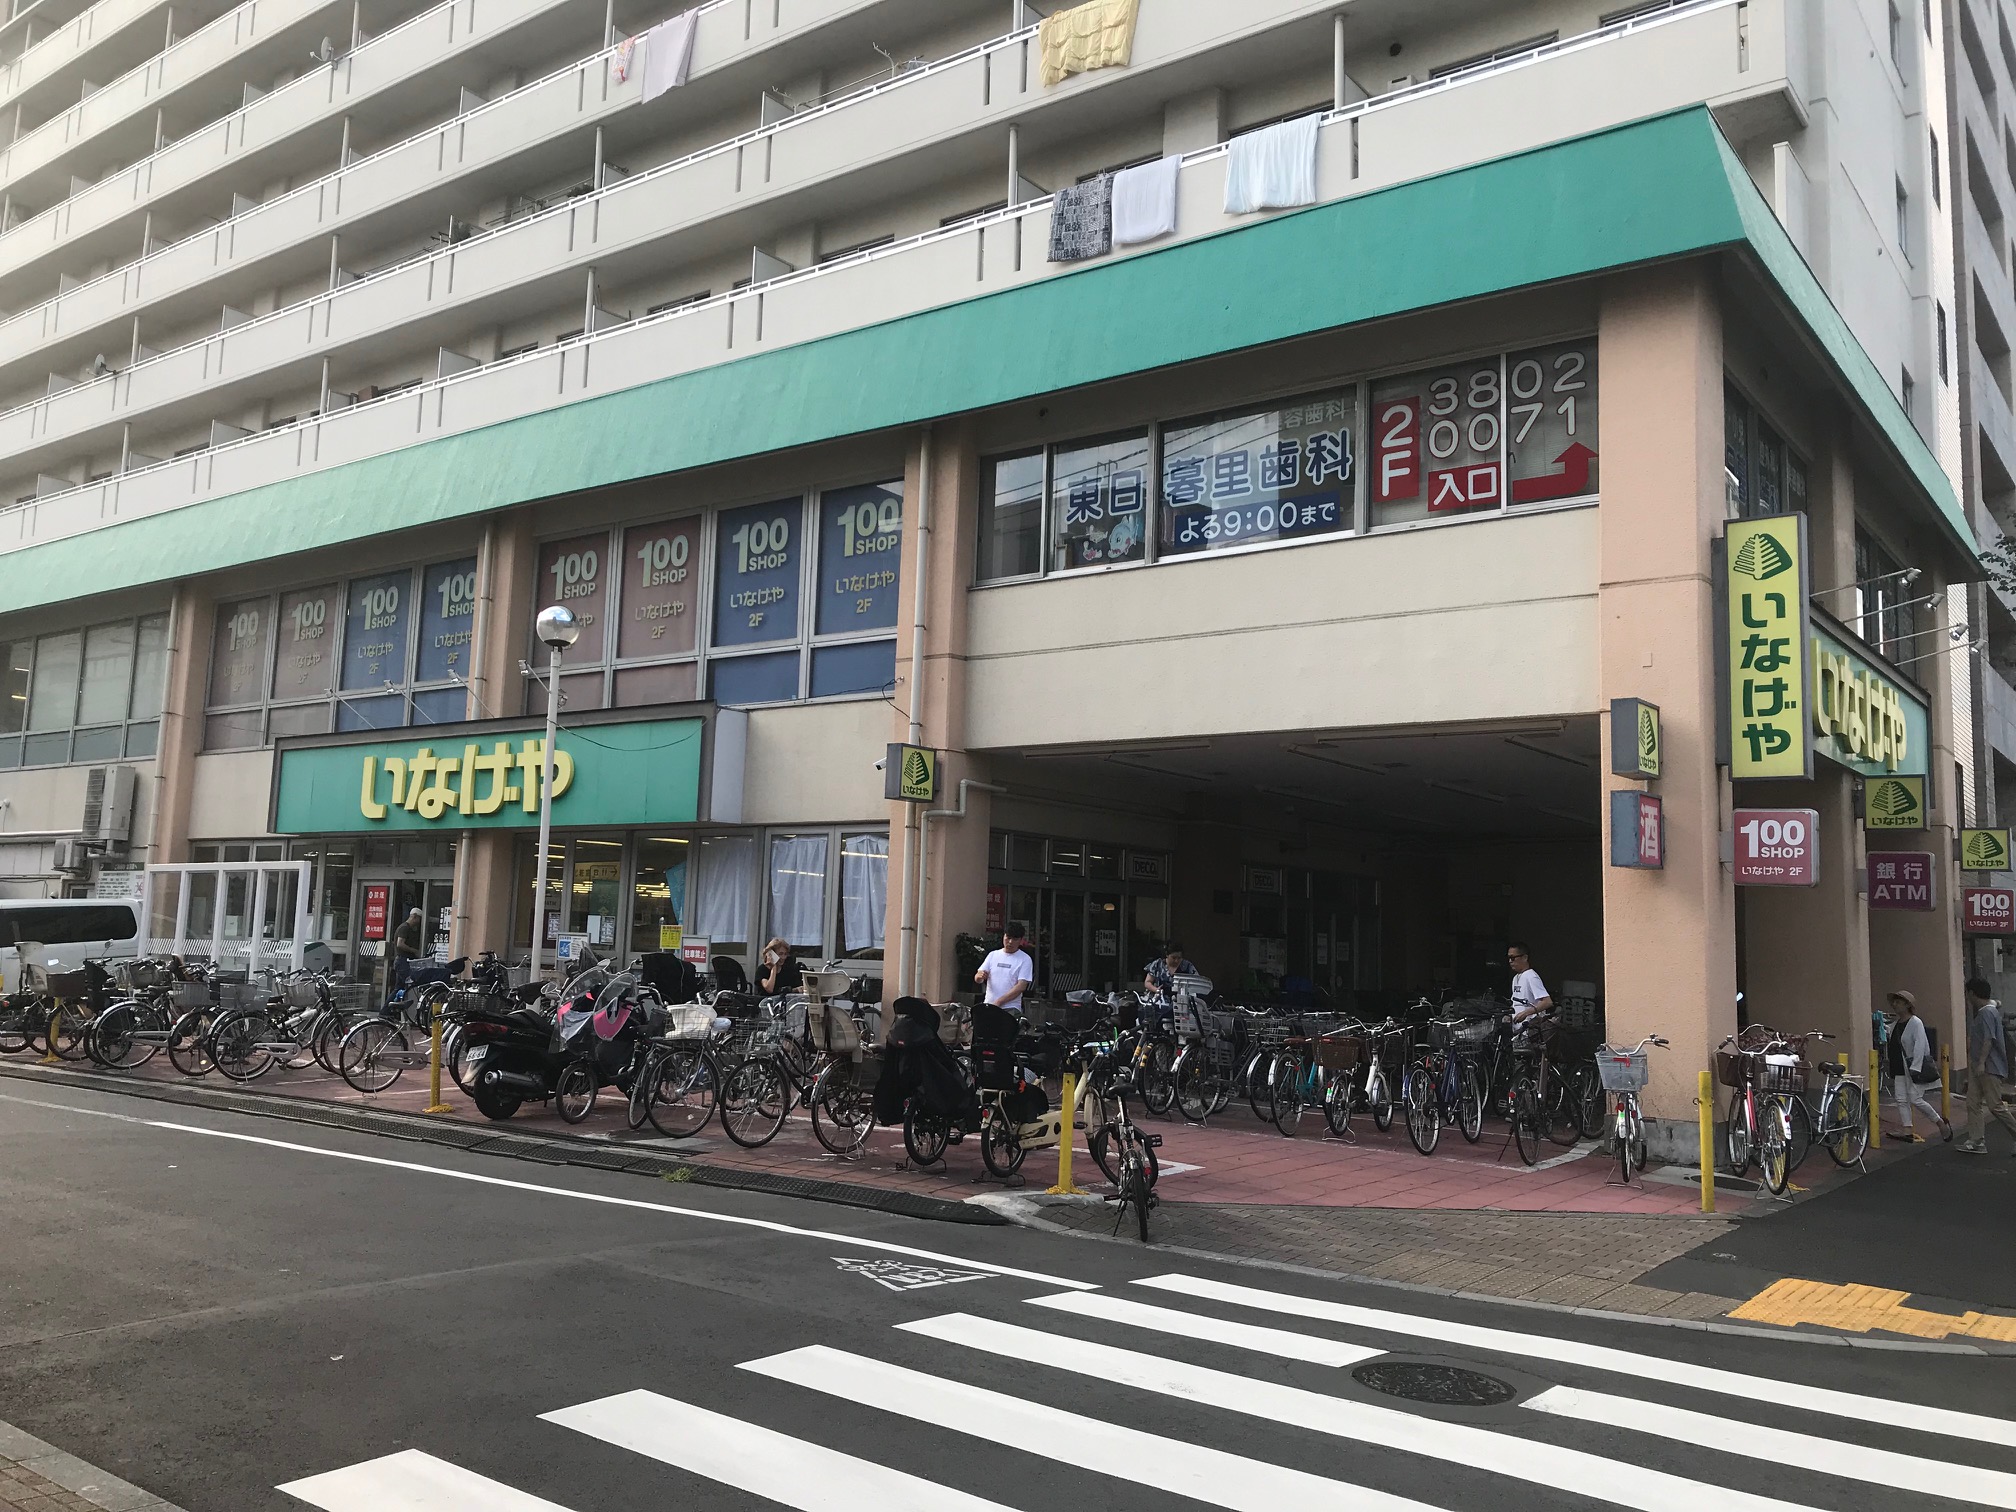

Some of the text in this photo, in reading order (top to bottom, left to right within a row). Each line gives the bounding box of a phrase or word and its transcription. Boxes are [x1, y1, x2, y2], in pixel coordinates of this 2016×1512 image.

[1428, 352, 1587, 416] 3802
[1428, 396, 1577, 459] 0071
[1381, 404, 1414, 497] 2F
[1066, 427, 1353, 524] 東日暮里歯科
[1433, 466, 1497, 505] 入口
[837, 498, 899, 557] 100
[1179, 501, 1335, 543] よる9:00まで
[638, 535, 689, 588] 100
[732, 517, 789, 573] 100
[749, 552, 787, 571] SHOP
[856, 534, 898, 555] SHOP
[551, 550, 597, 600] 100
[564, 582, 595, 599] SHOP
[652, 568, 687, 586] SHOP
[361, 586, 398, 630] 100
[438, 572, 476, 618] 100
[856, 598, 872, 613] 2F
[228, 611, 259, 651] 100
[291, 599, 326, 641] 100
[300, 626, 324, 640] SHOP
[371, 614, 396, 629] SHOP
[651, 625, 666, 639] 2F
[748, 612, 763, 627] 2F
[1740, 592, 1796, 762] いなげや
[1810, 638, 1907, 772] いなげや
[360, 739, 575, 819] いなげや
[1640, 803, 1659, 860] 酒
[1740, 819, 1805, 858] 100
[1871, 816, 1919, 826] いなげや
[1741, 866, 1803, 876] いなげや 2F
[1760, 846, 1804, 858] SHOP
[1876, 862, 1923, 880] 銀行
[1874, 885, 1927, 900] ATM
[1968, 893, 2010, 916] 100
[1982, 909, 2010, 917] SHOP
